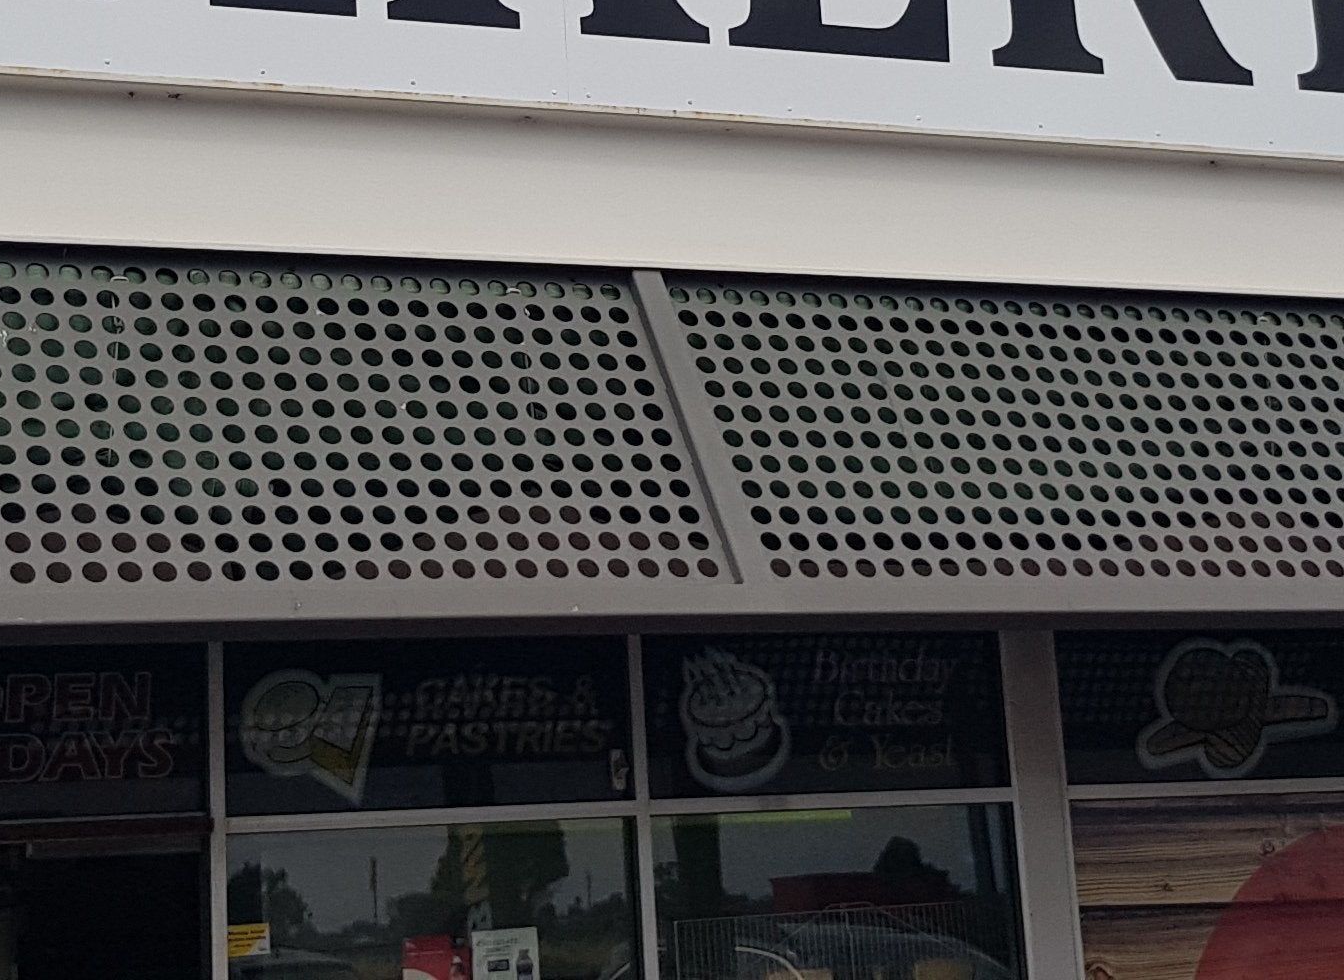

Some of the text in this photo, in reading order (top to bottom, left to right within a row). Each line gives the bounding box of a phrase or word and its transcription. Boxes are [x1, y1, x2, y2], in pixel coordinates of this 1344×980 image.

[812, 645, 958, 693] Birthday
[414, 672, 557, 720] CAKES
[834, 689, 944, 725] Cakes
[405, 719, 611, 757] PASTRIES
